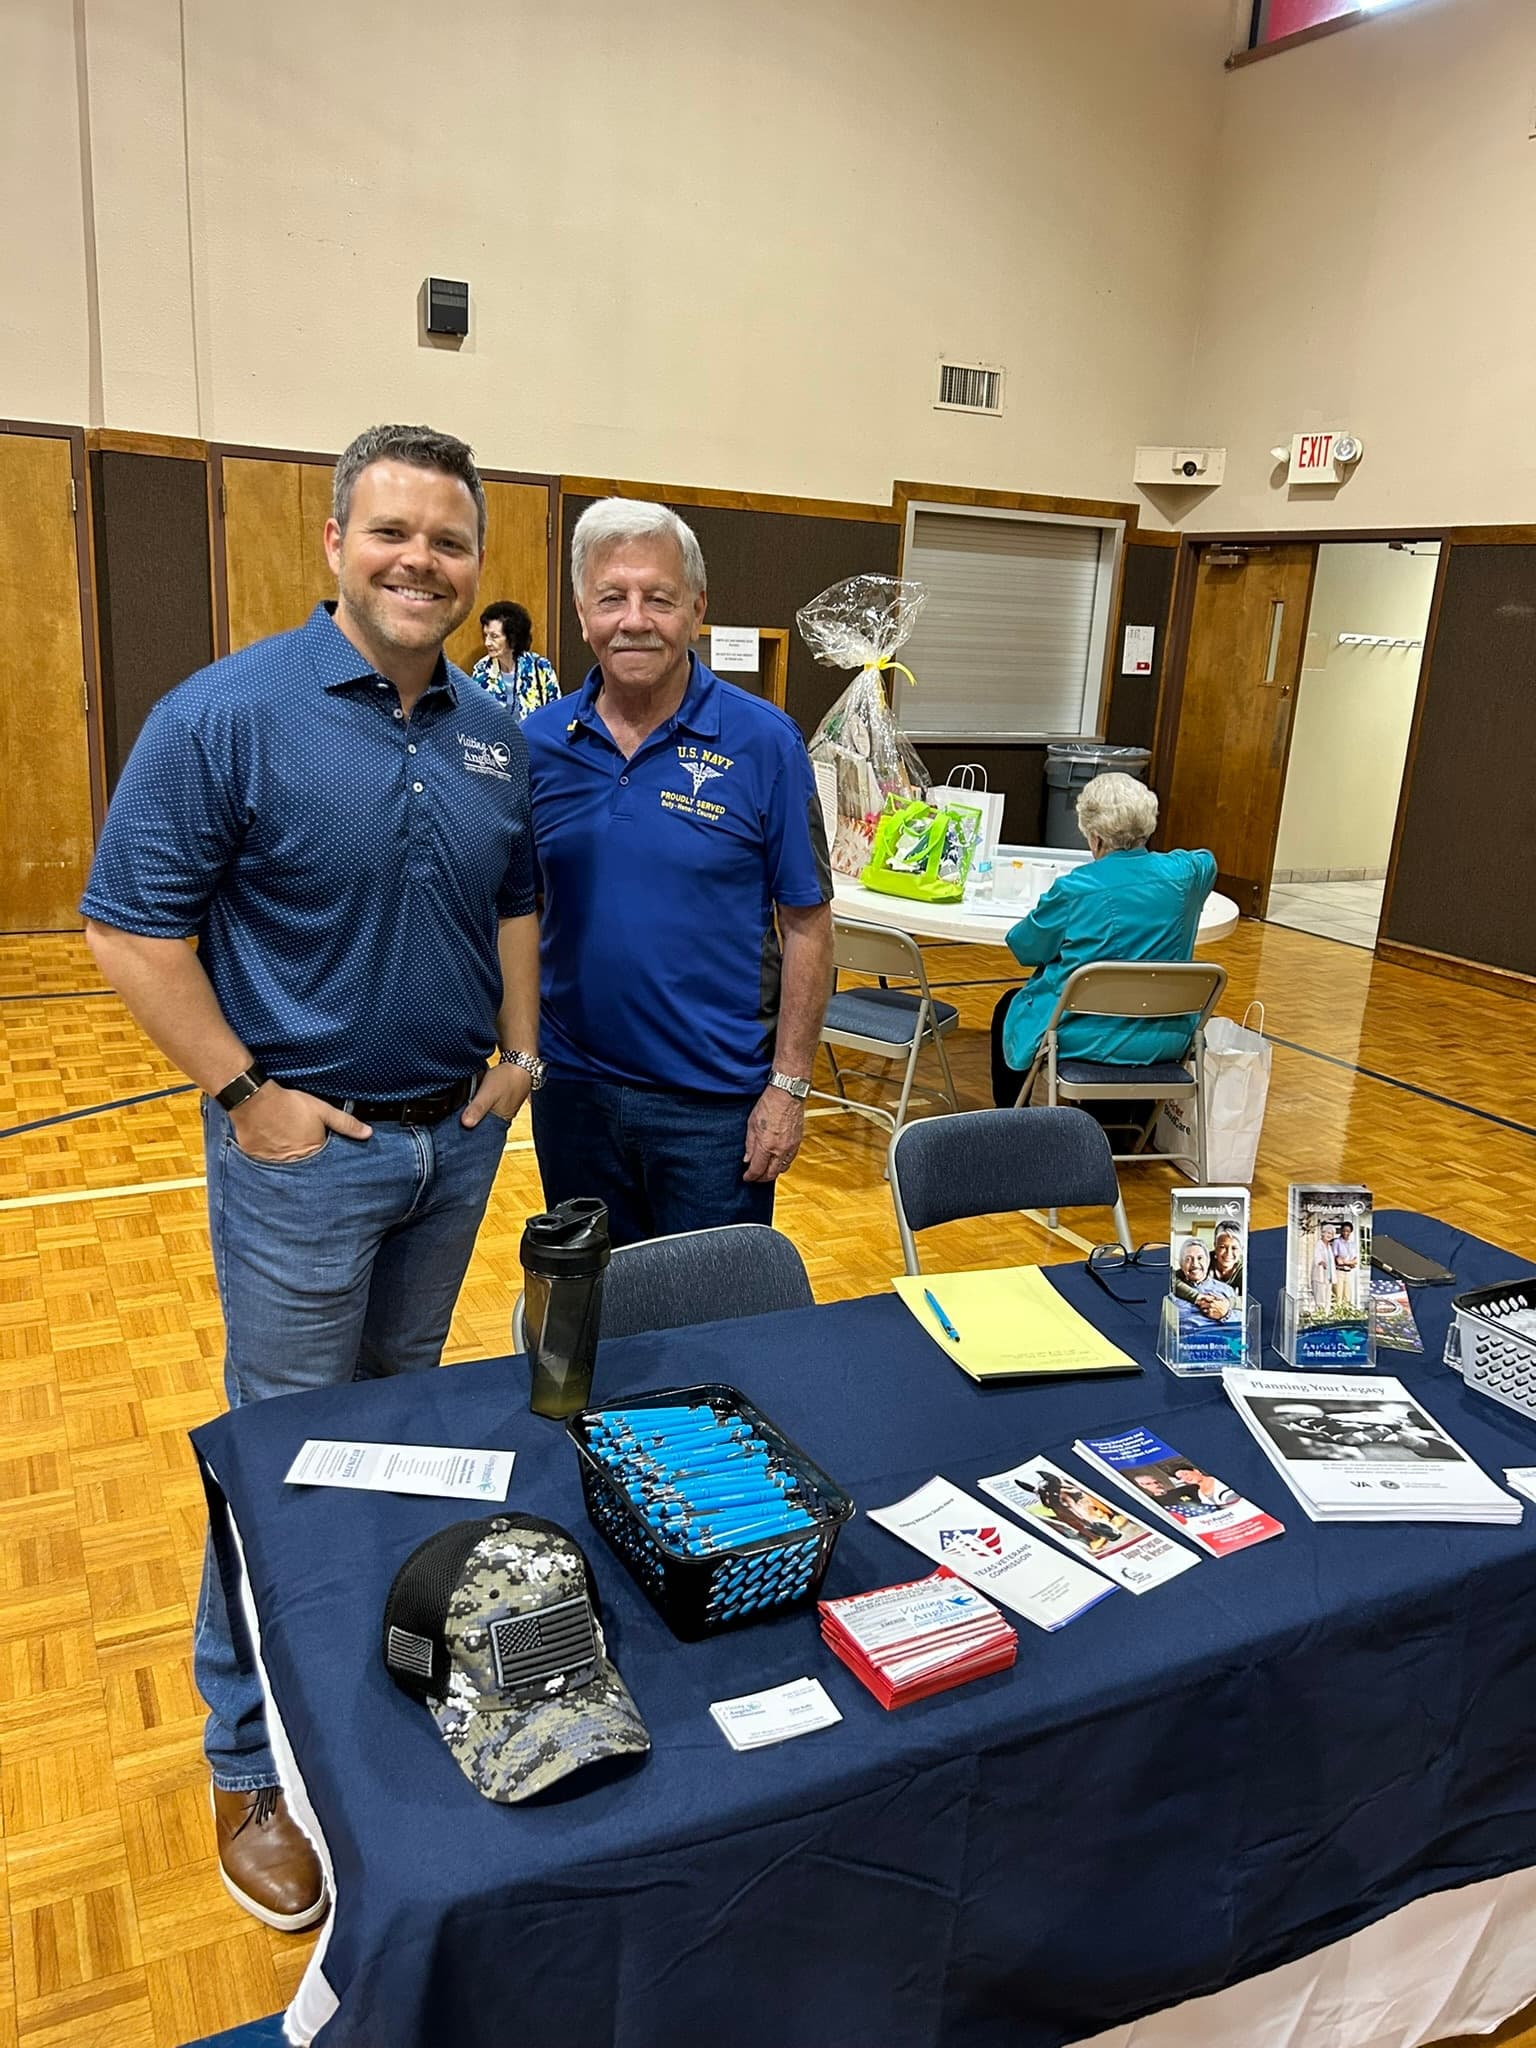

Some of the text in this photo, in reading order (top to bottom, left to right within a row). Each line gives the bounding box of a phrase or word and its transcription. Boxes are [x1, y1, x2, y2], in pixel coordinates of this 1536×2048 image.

[1298, 435, 1333, 468] EXIT
[677, 746, 735, 770] U.S. NAVY
[660, 790, 726, 815] PROUDLY SERVED
[1250, 1381, 1310, 1393] Planning
[1310, 1383, 1340, 1392] Your
[1341, 1385, 1385, 1395] Legacy
[1350, 1480, 1373, 1488] VA
[973, 1543, 1032, 1577] TEXAS VETERANS
[989, 1552, 1033, 1579] COMMISSION
[899, 1599, 945, 1615] Visiting
[913, 1604, 958, 1622] Angels
